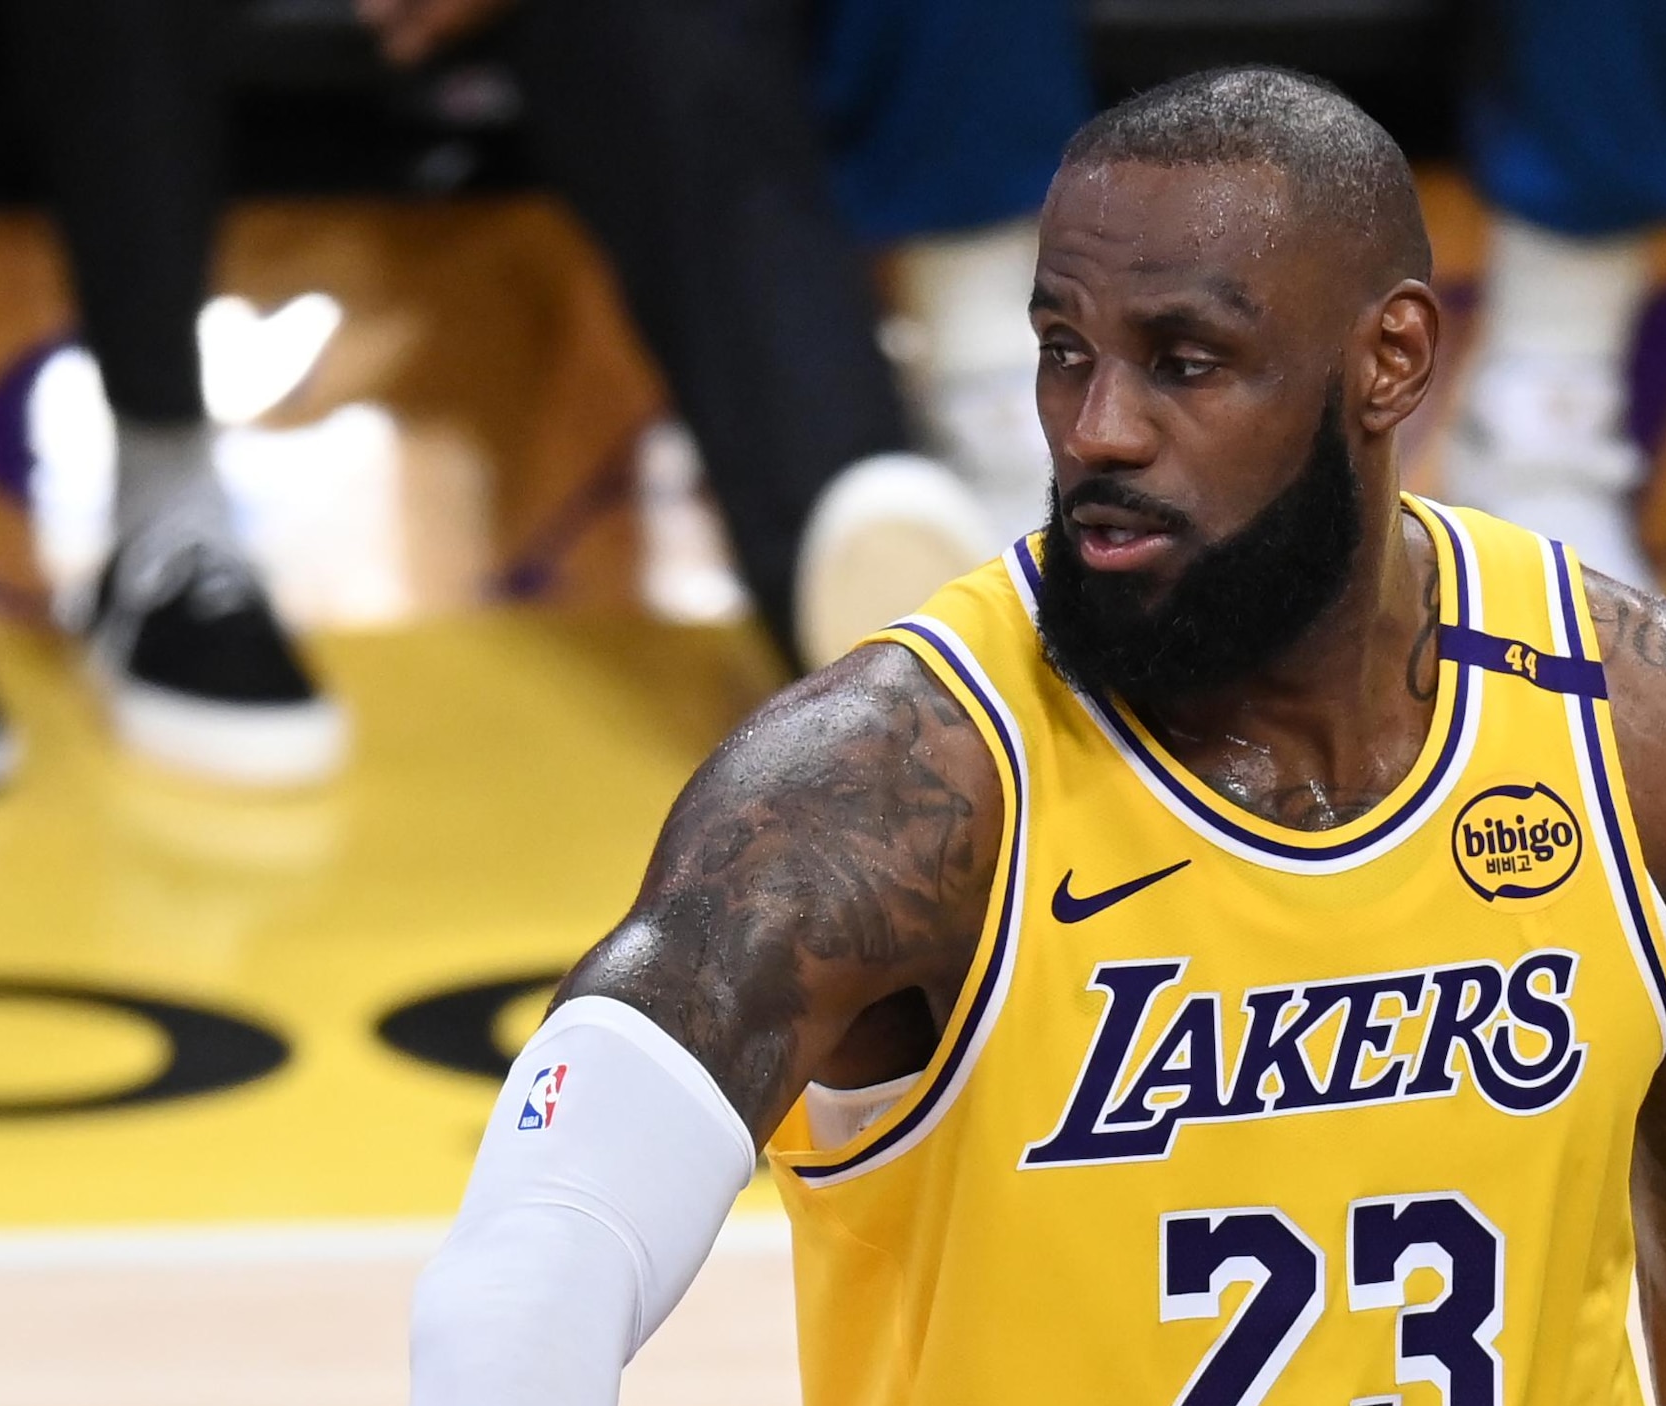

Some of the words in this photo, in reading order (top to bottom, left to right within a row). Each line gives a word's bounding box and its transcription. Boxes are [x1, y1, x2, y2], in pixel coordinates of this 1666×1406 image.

[1505, 643, 1537, 681] 44
[1462, 814, 1573, 862] bibigo
[1486, 855, 1533, 875] 비비고
[1017, 947, 1589, 1170] LAKERS
